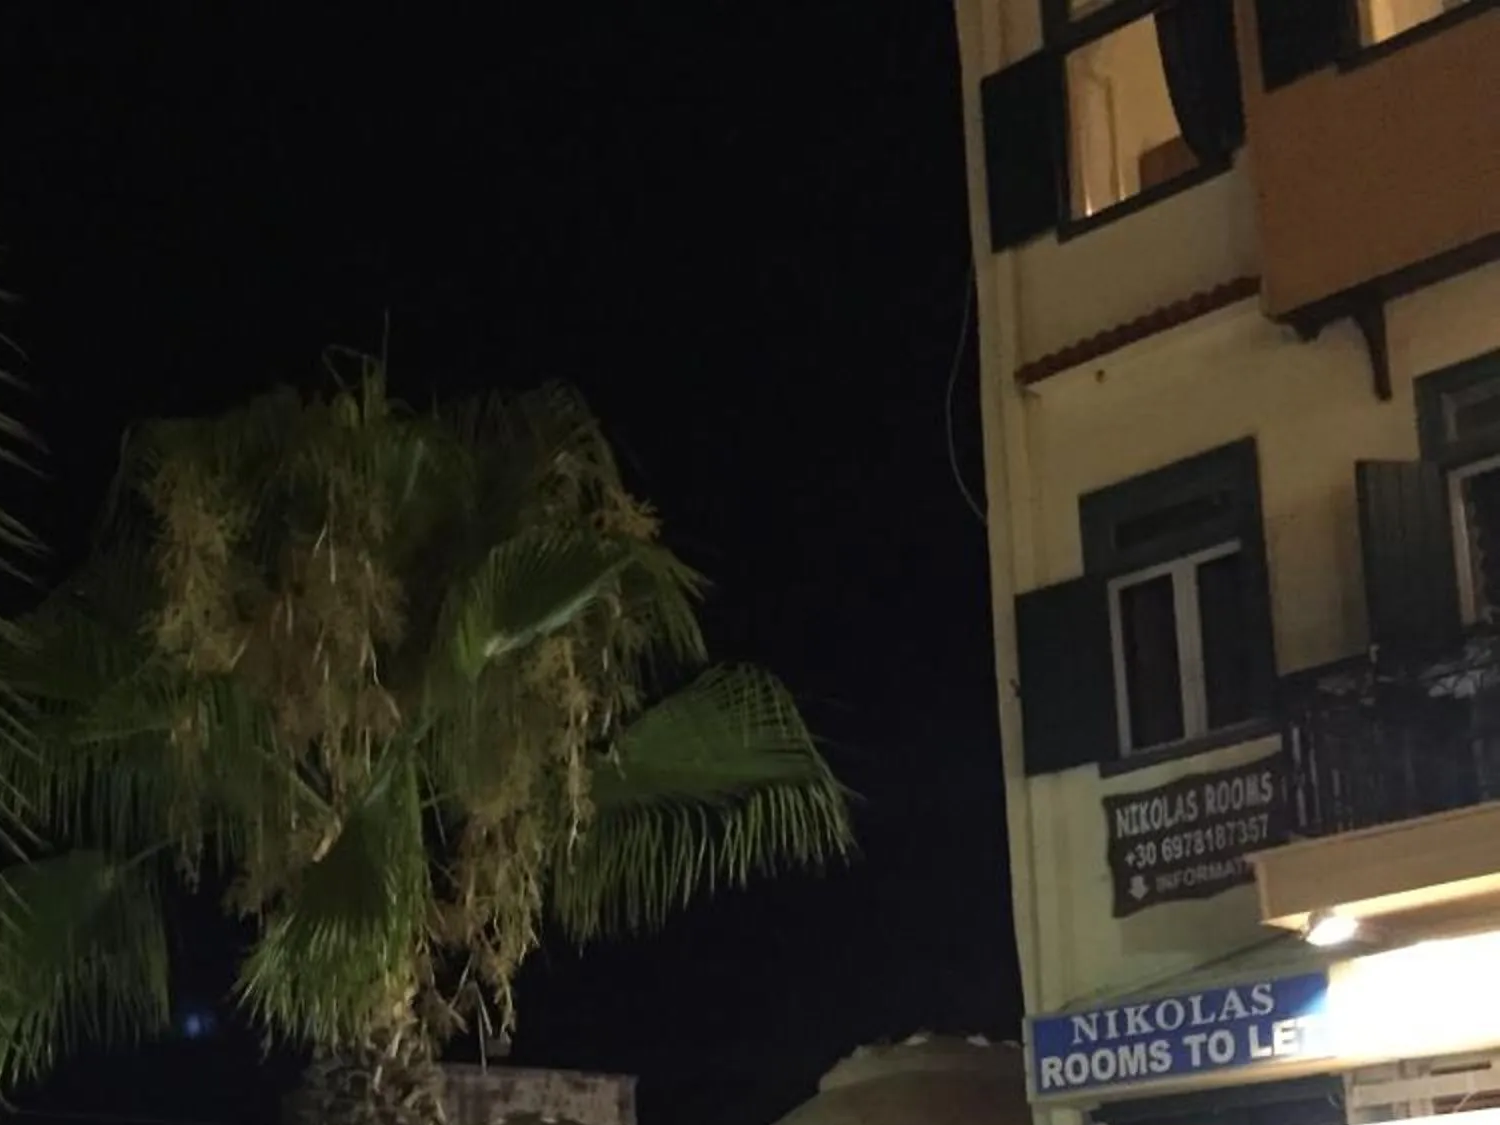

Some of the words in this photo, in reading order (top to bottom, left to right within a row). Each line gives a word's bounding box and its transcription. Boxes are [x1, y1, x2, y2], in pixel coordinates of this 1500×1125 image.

[1116, 789, 1198, 838] NIKOLAS
[1204, 772, 1273, 816] ROOMS
[1125, 842, 1157, 869] +30
[1155, 856, 1248, 892] INFORMAT
[1072, 983, 1275, 1045] NIKOLAS
[1041, 1040, 1172, 1089] ROOMS
[1182, 1029, 1235, 1067] TO
[1249, 1018, 1303, 1059] LE
